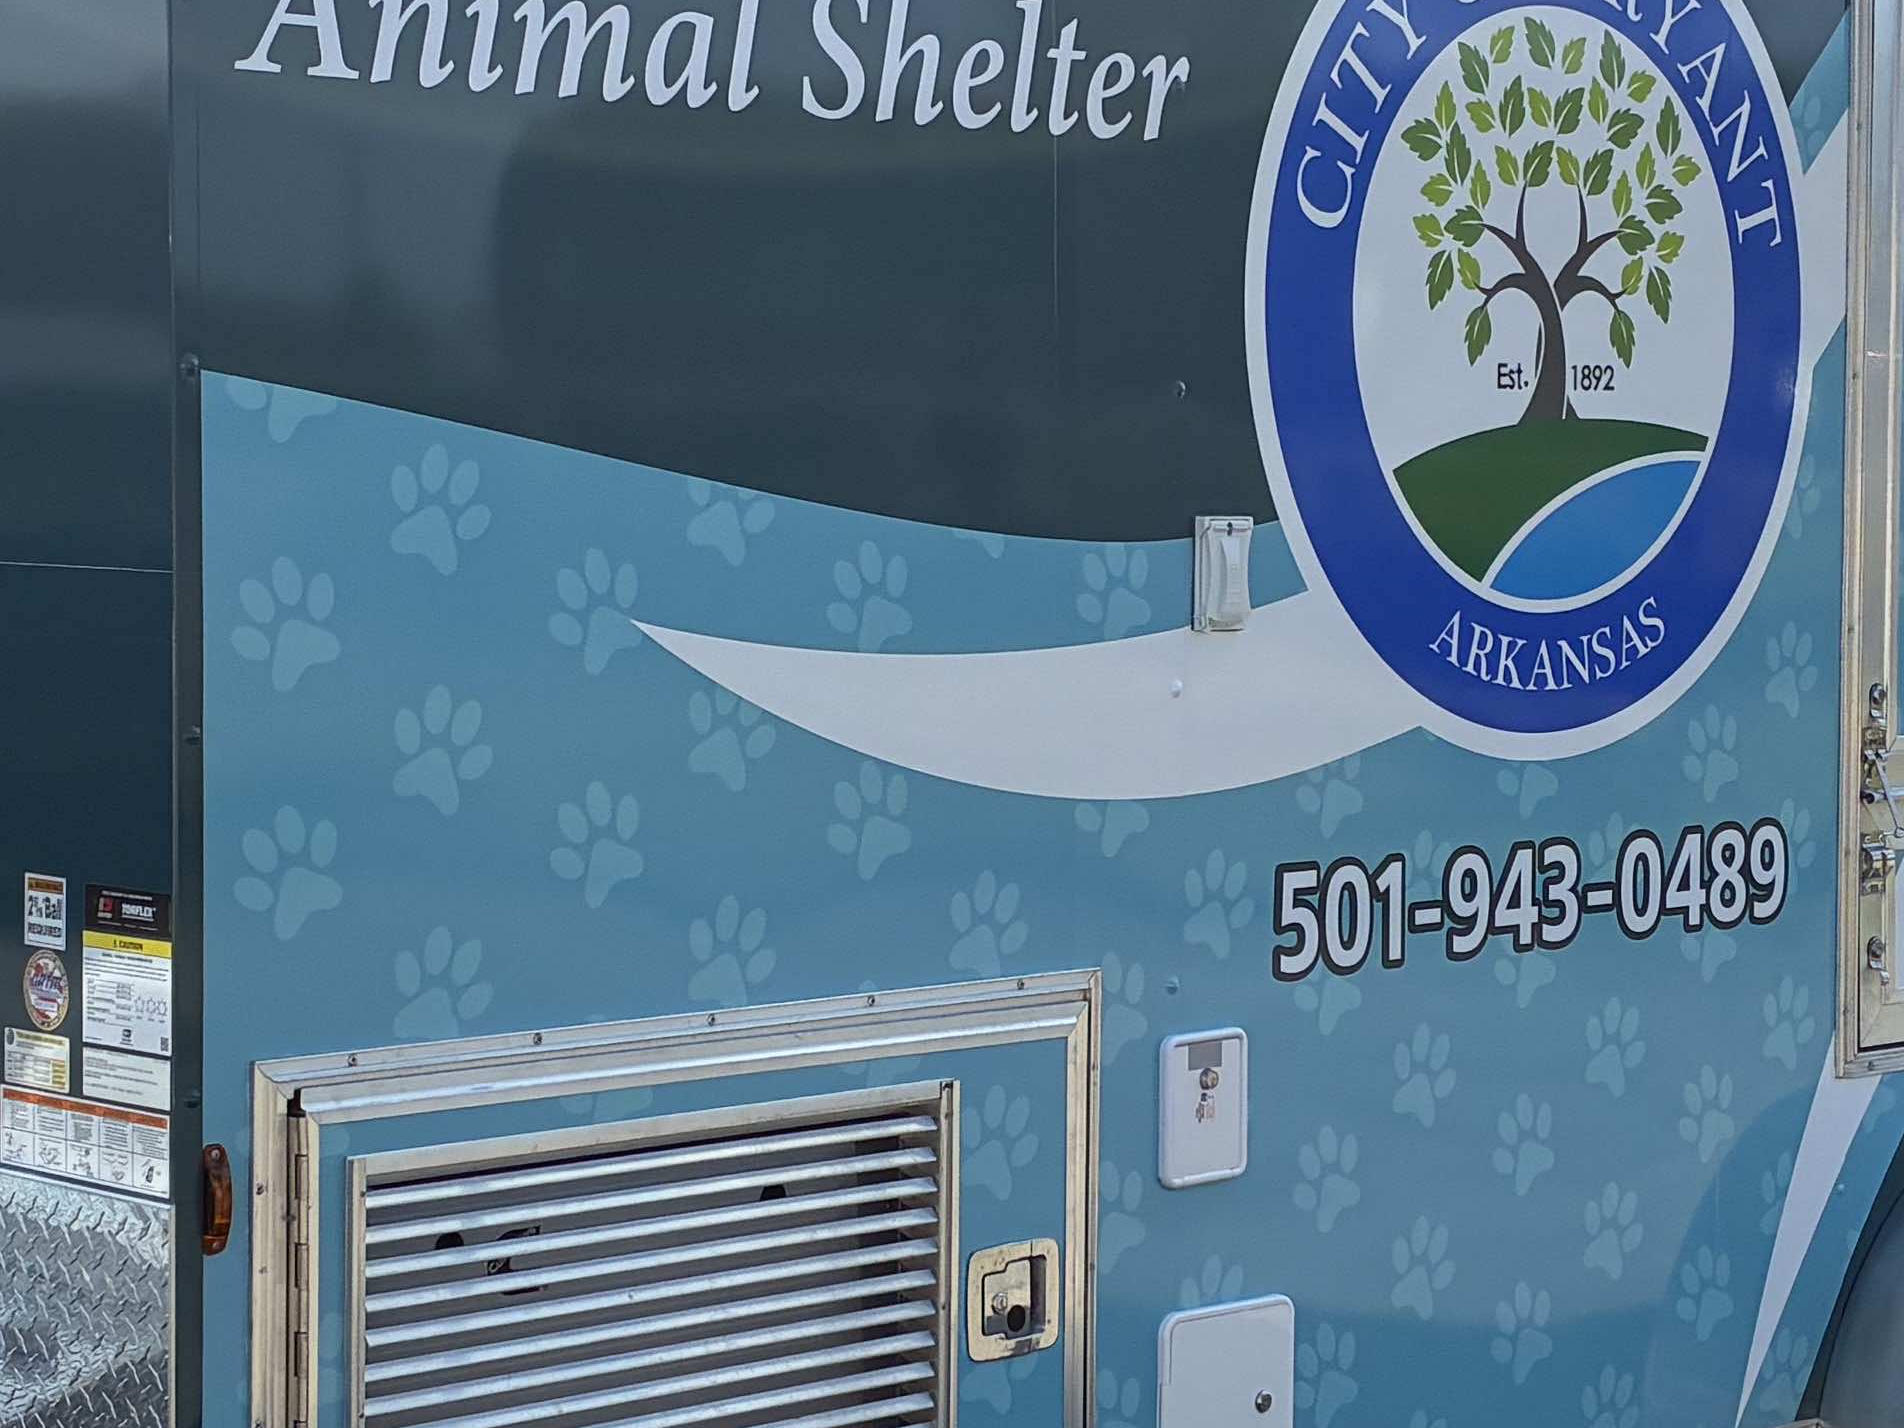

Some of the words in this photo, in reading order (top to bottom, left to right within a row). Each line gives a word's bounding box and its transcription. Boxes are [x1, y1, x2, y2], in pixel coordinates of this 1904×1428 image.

[1497, 362, 1529, 390] Est.
[1570, 363, 1615, 392] 1892
[1428, 595, 1667, 691] ARKANSAS
[1272, 817, 1790, 983] 501-943-0489
